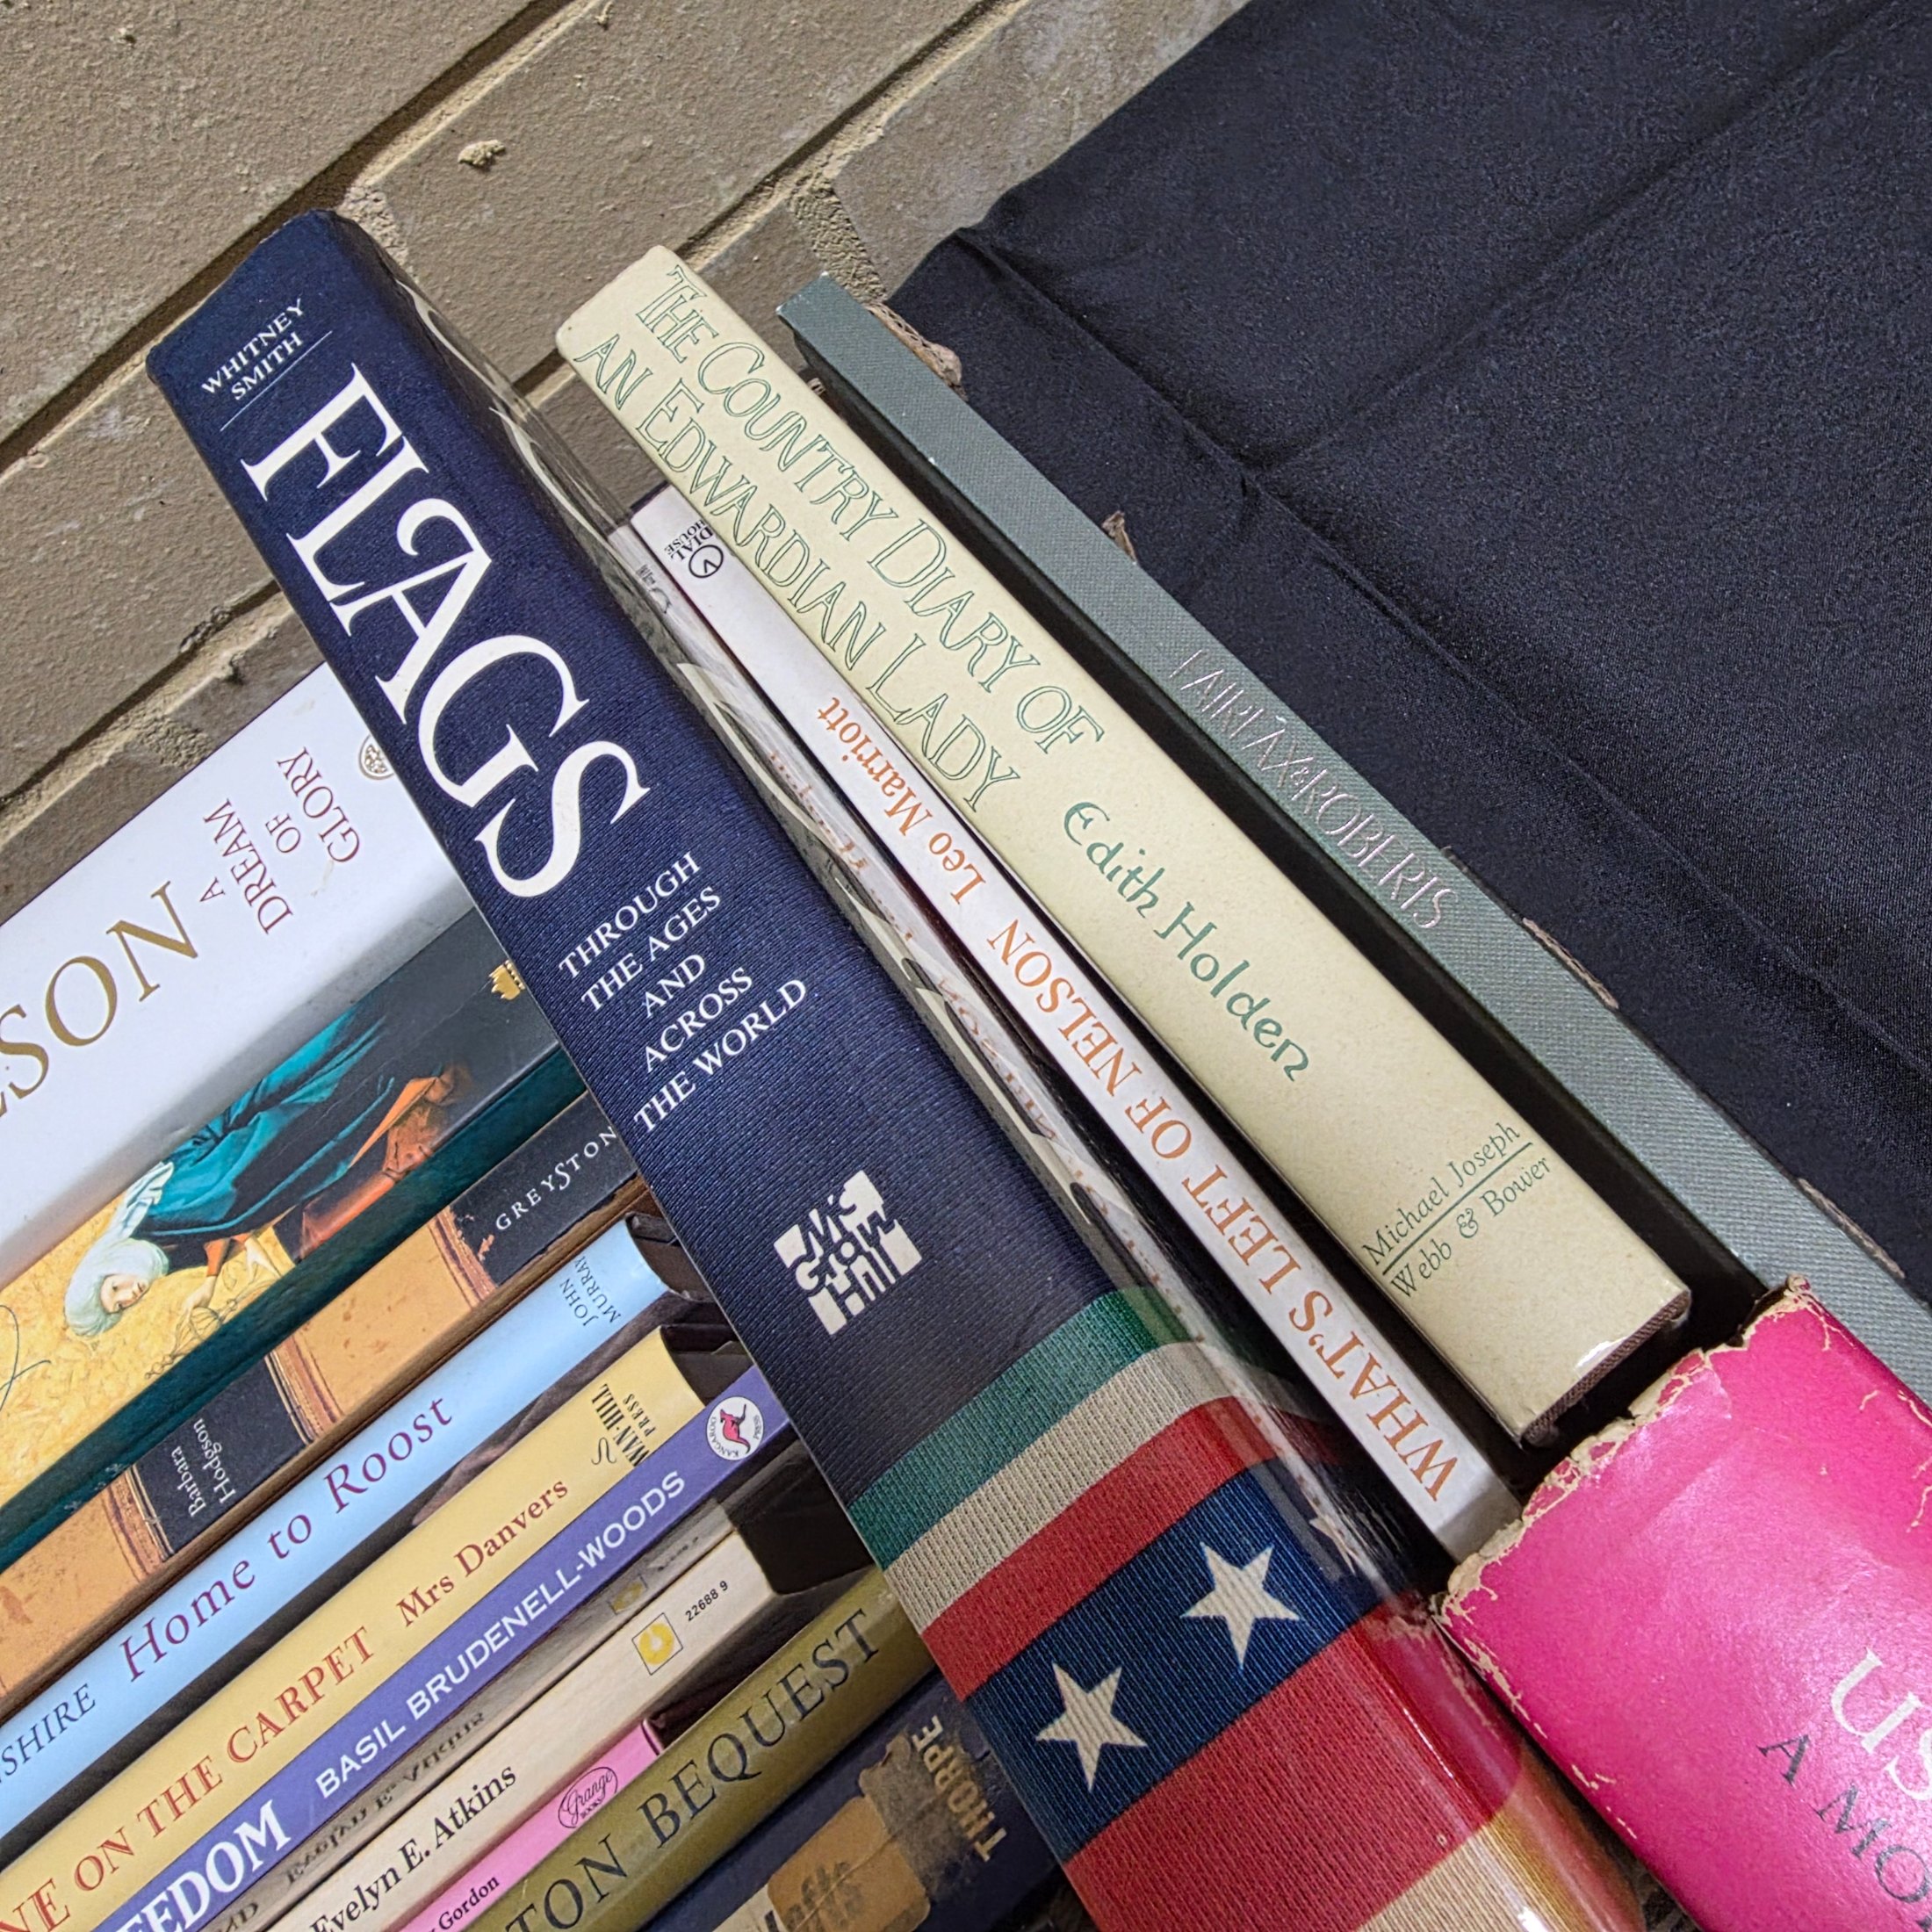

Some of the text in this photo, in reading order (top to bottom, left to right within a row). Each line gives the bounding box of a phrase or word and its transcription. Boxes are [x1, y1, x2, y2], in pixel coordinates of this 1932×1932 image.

[201, 299, 305, 396] WHITNEY
[230, 332, 304, 401] SMITH
[635, 265, 1105, 754] THE COUNTRY DIARY OF
[664, 520, 707, 556] HOUSE
[671, 526, 714, 561] DIAL
[241, 362, 651, 898] FLAGS
[573, 334, 652, 412] AN
[635, 378, 886, 671] EDWARDIAN
[866, 633, 1020, 813] LADY
[277, 746, 361, 863] GLORY
[816, 696, 933, 837] Marriott
[199, 877, 226, 903] A
[204, 798, 294, 934] DREAM
[264, 813, 302, 854] OF
[928, 832, 986, 905] Leo
[559, 852, 701, 980] THROUGH
[580, 886, 722, 1013] THE AGES
[1063, 801, 1310, 1083] Edith Holden
[0, 881, 198, 1117] SON
[643, 954, 706, 1019] AND
[643, 967, 753, 1073] ACROSS
[986, 919, 1142, 1098] NELSON
[633, 978, 807, 1133] THE WORLD
[495, 1126, 617, 1231] GREYSTON
[1124, 1095, 1193, 1159] OF
[1181, 1164, 1301, 1295] LEFT
[1361, 1121, 1520, 1266] Michael Joseph
[1390, 1157, 1552, 1299] Webb & Bower
[559, 1279, 599, 1327] JOHN
[573, 1255, 622, 1323] MURRAY
[623, 1393, 656, 1437] PRESS
[1287, 1289, 1459, 1503] WHAT'S
[171, 1445, 207, 1517] Barbara
[193, 1418, 236, 1504] Hodgson
[0, 1396, 452, 1777] SHIRE Home to Roost
[315, 1719, 407, 1799] BASIL
[406, 1470, 686, 1721] BRUDENELL-WOODS
[685, 1580, 728, 1622] 22688 9
[74, 1826, 134, 1892] ON
[136, 1755, 224, 1839] THE
[226, 1626, 374, 1764] CARPET
[395, 1572, 455, 1627] Mrs
[453, 1479, 568, 1578] Danvers
[637, 1608, 879, 1849] BEQUEST
[309, 1867, 402, 1932] Evelyn
[398, 1837, 431, 1873] E.
[433, 1765, 516, 1849] Atkins
[562, 1769, 614, 1826] Grange
[1755, 1734, 1932, 1932] A MO
[437, 1876, 501, 1931] Gordon
